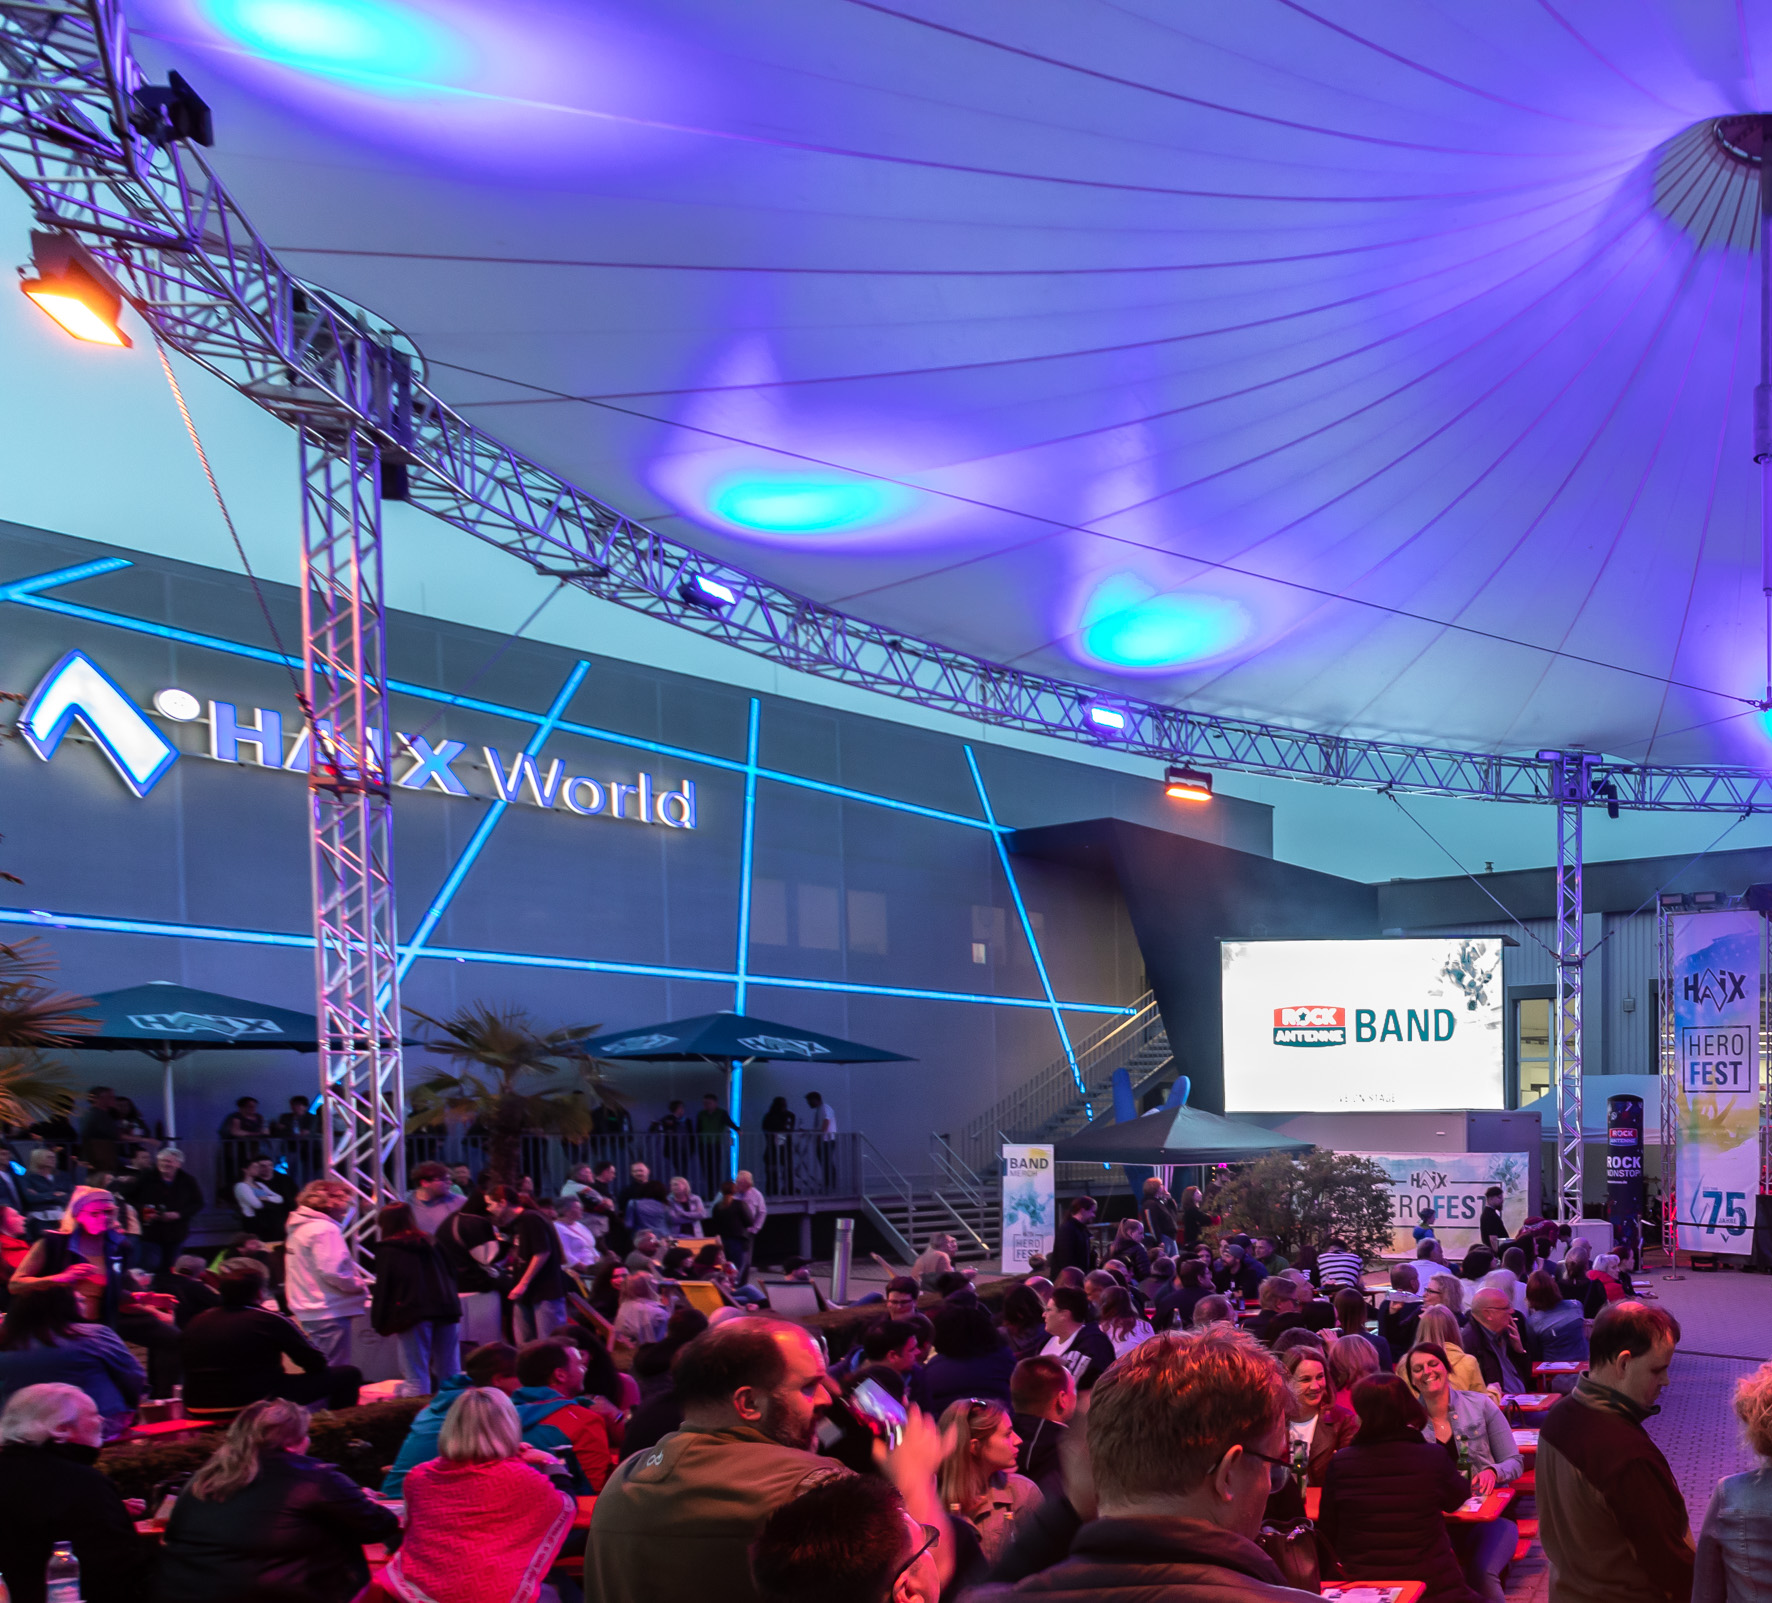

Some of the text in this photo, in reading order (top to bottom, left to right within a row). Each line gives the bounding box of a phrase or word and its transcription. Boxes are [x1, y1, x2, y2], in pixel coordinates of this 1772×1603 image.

[482, 745, 697, 829] World
[1684, 968, 1747, 1012] HAIX
[1282, 1007, 1337, 1026] ROCK
[1355, 1009, 1455, 1042] BAND
[1275, 1030, 1344, 1043] ANTENNE
[1689, 1034, 1744, 1056] HERO
[1690, 1061, 1742, 1085] FEST
[1009, 1158, 1049, 1169] BAND
[1607, 1156, 1642, 1168] ROCK
[1410, 1170, 1447, 1193] HAIX
[1702, 1191, 1747, 1237] 75
[1016, 1239, 1040, 1248] HERO
